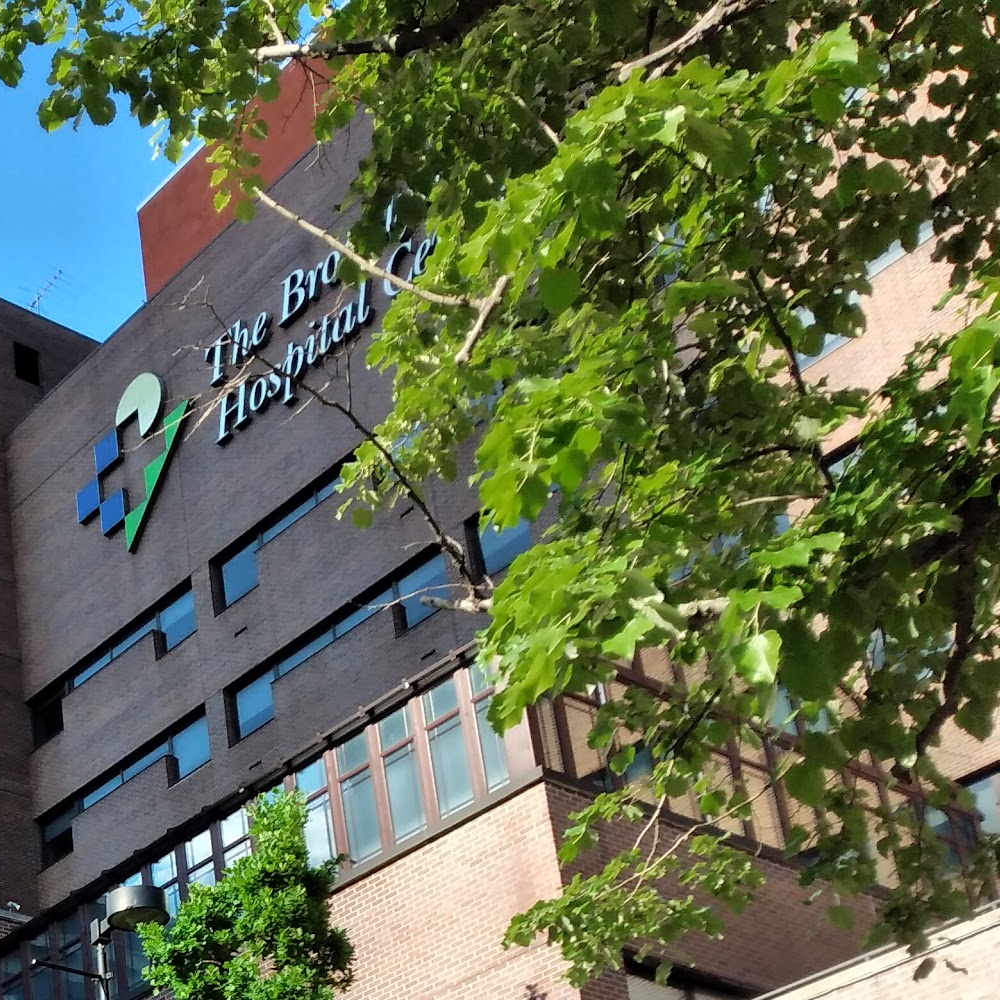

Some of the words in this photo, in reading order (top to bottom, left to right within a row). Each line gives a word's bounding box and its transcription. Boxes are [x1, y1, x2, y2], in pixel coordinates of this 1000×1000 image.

[204, 310, 269, 387] The
[278, 250, 342, 328] Bro
[215, 277, 371, 445] Hospital
[383, 230, 439, 297] Ce
